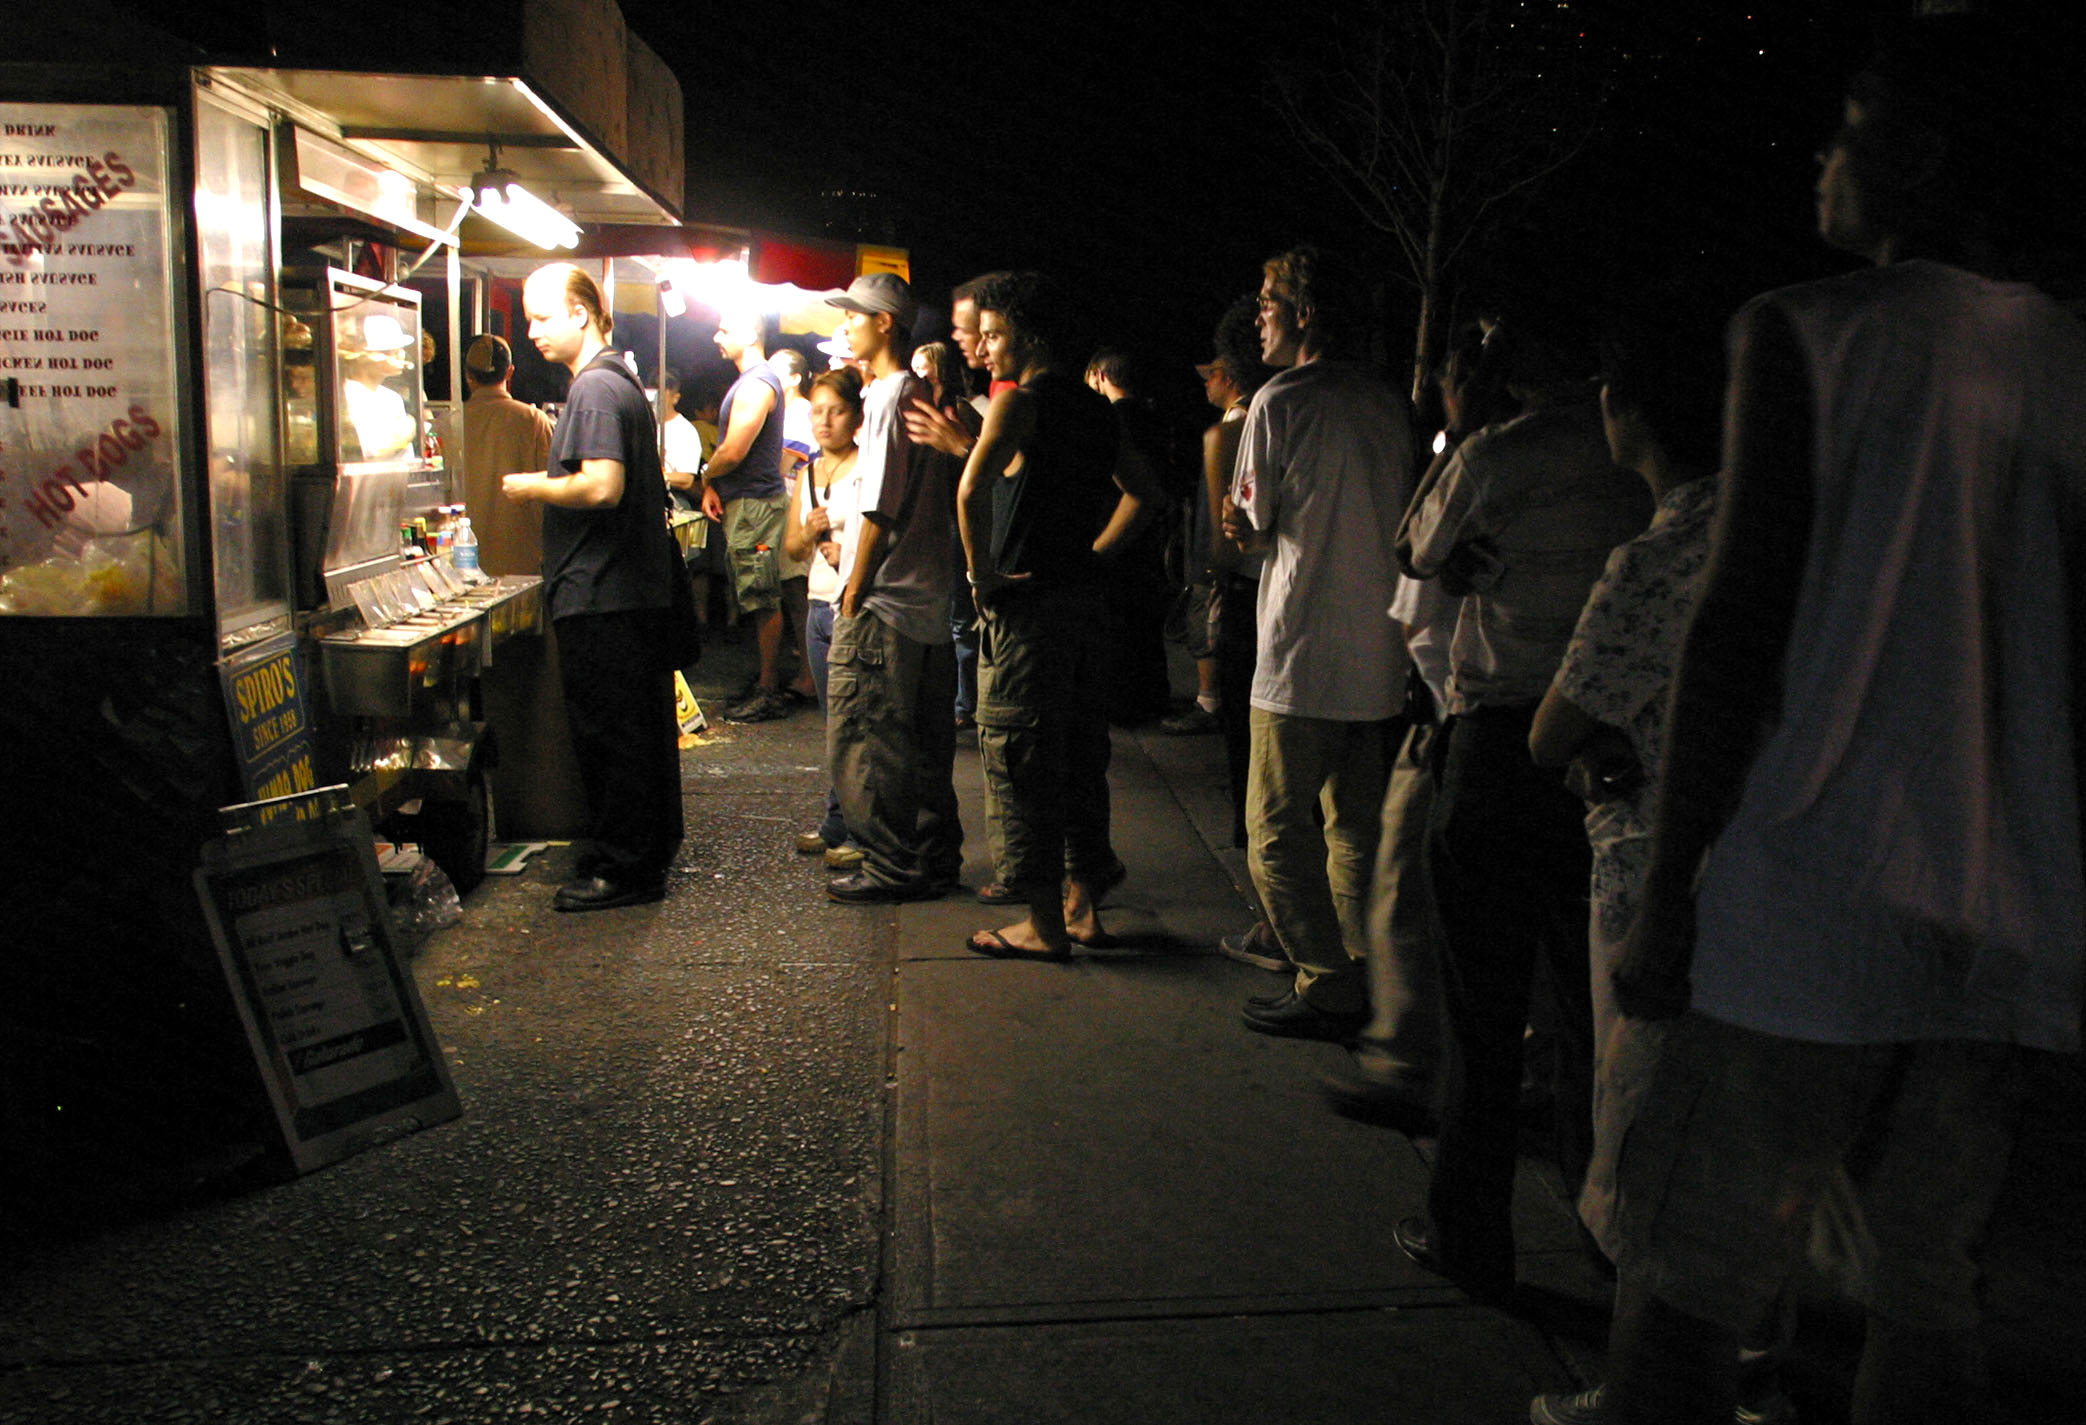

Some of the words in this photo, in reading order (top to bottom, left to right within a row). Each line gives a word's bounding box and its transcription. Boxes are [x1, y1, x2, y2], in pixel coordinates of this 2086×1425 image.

[23, 464, 89, 530] HOT
[77, 403, 161, 483] DOGS
[235, 656, 296, 724] SPIRO'S
[253, 716, 281, 750] SINCE
